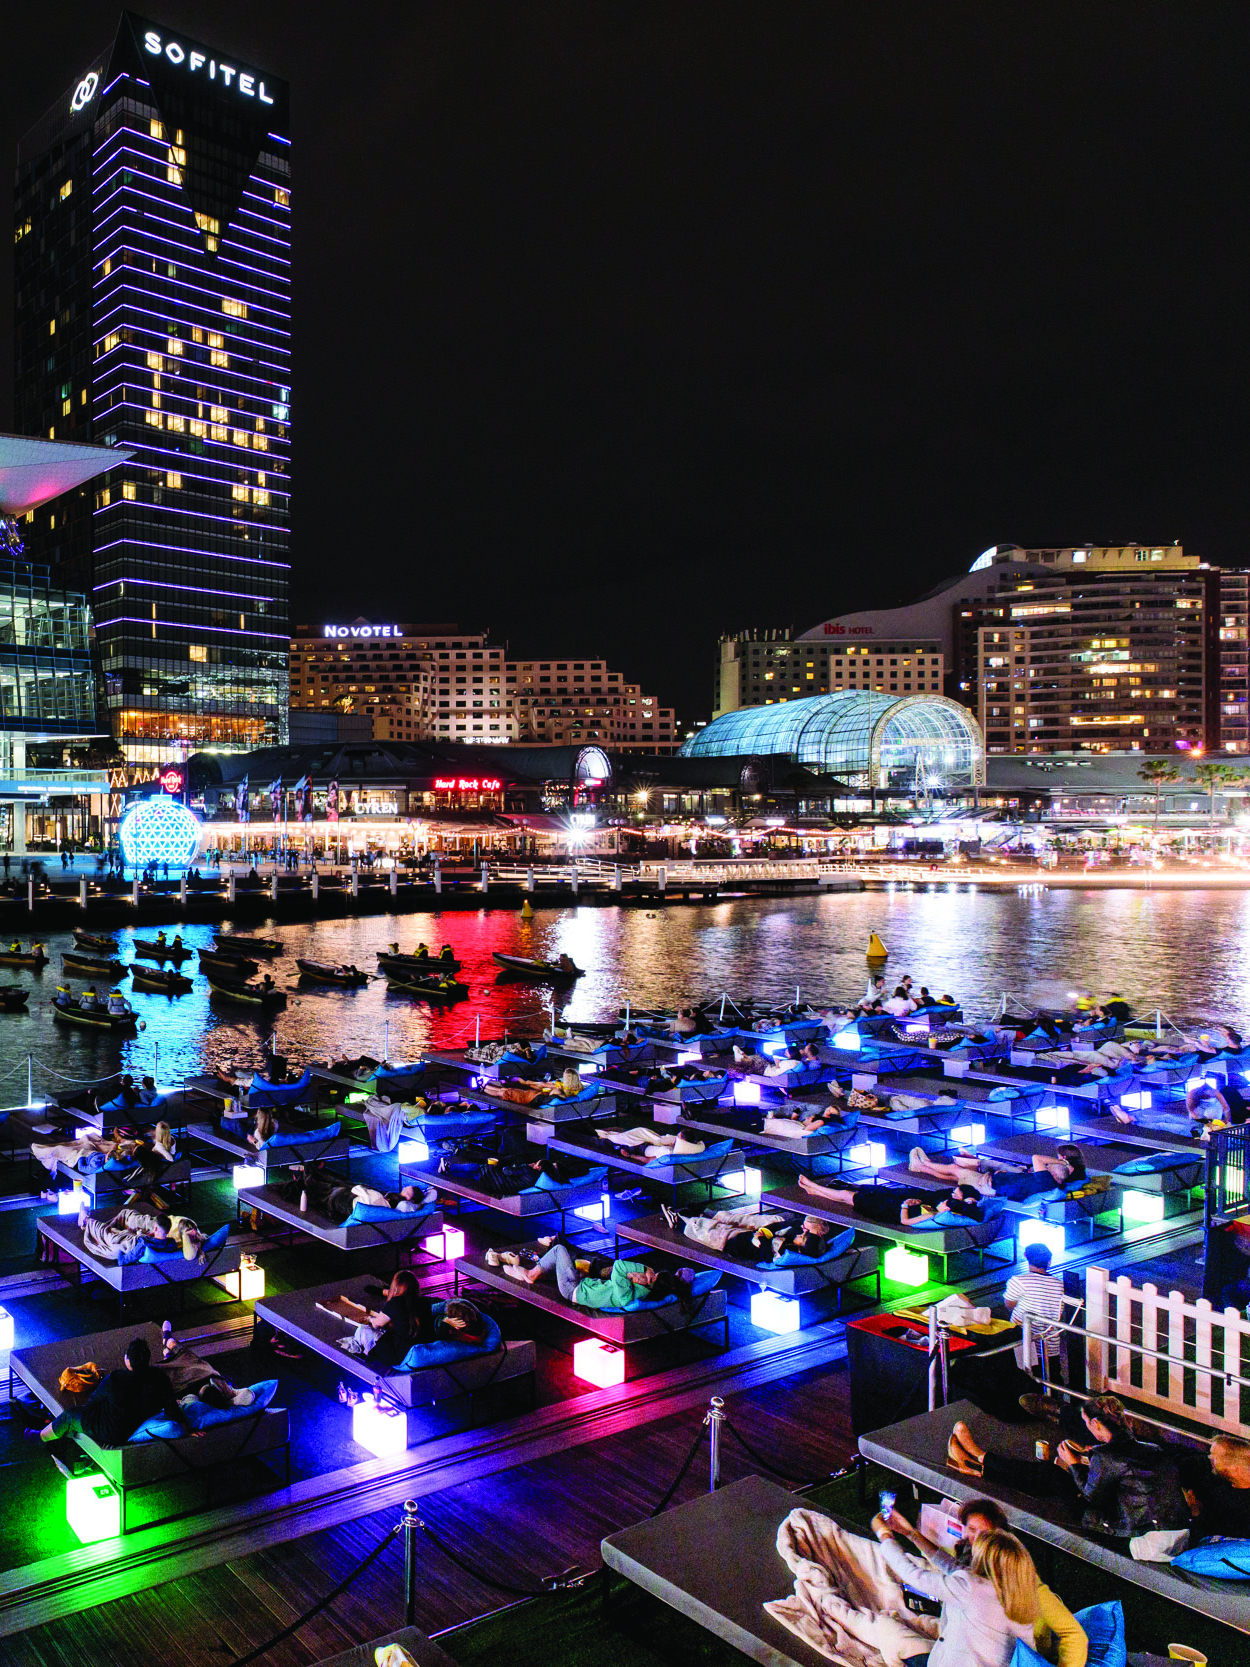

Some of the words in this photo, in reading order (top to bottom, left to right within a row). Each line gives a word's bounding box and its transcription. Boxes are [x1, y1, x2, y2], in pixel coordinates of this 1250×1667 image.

[144, 31, 275, 105] SOFITEL
[324, 625, 403, 637] NOVOTEL
[824, 623, 846, 635] ibis
[848, 627, 874, 635] HOTEL
[435, 779, 456, 789] Hard
[459, 779, 479, 790] Rock
[482, 779, 501, 790] Cafe
[355, 802, 398, 814] CYREN
